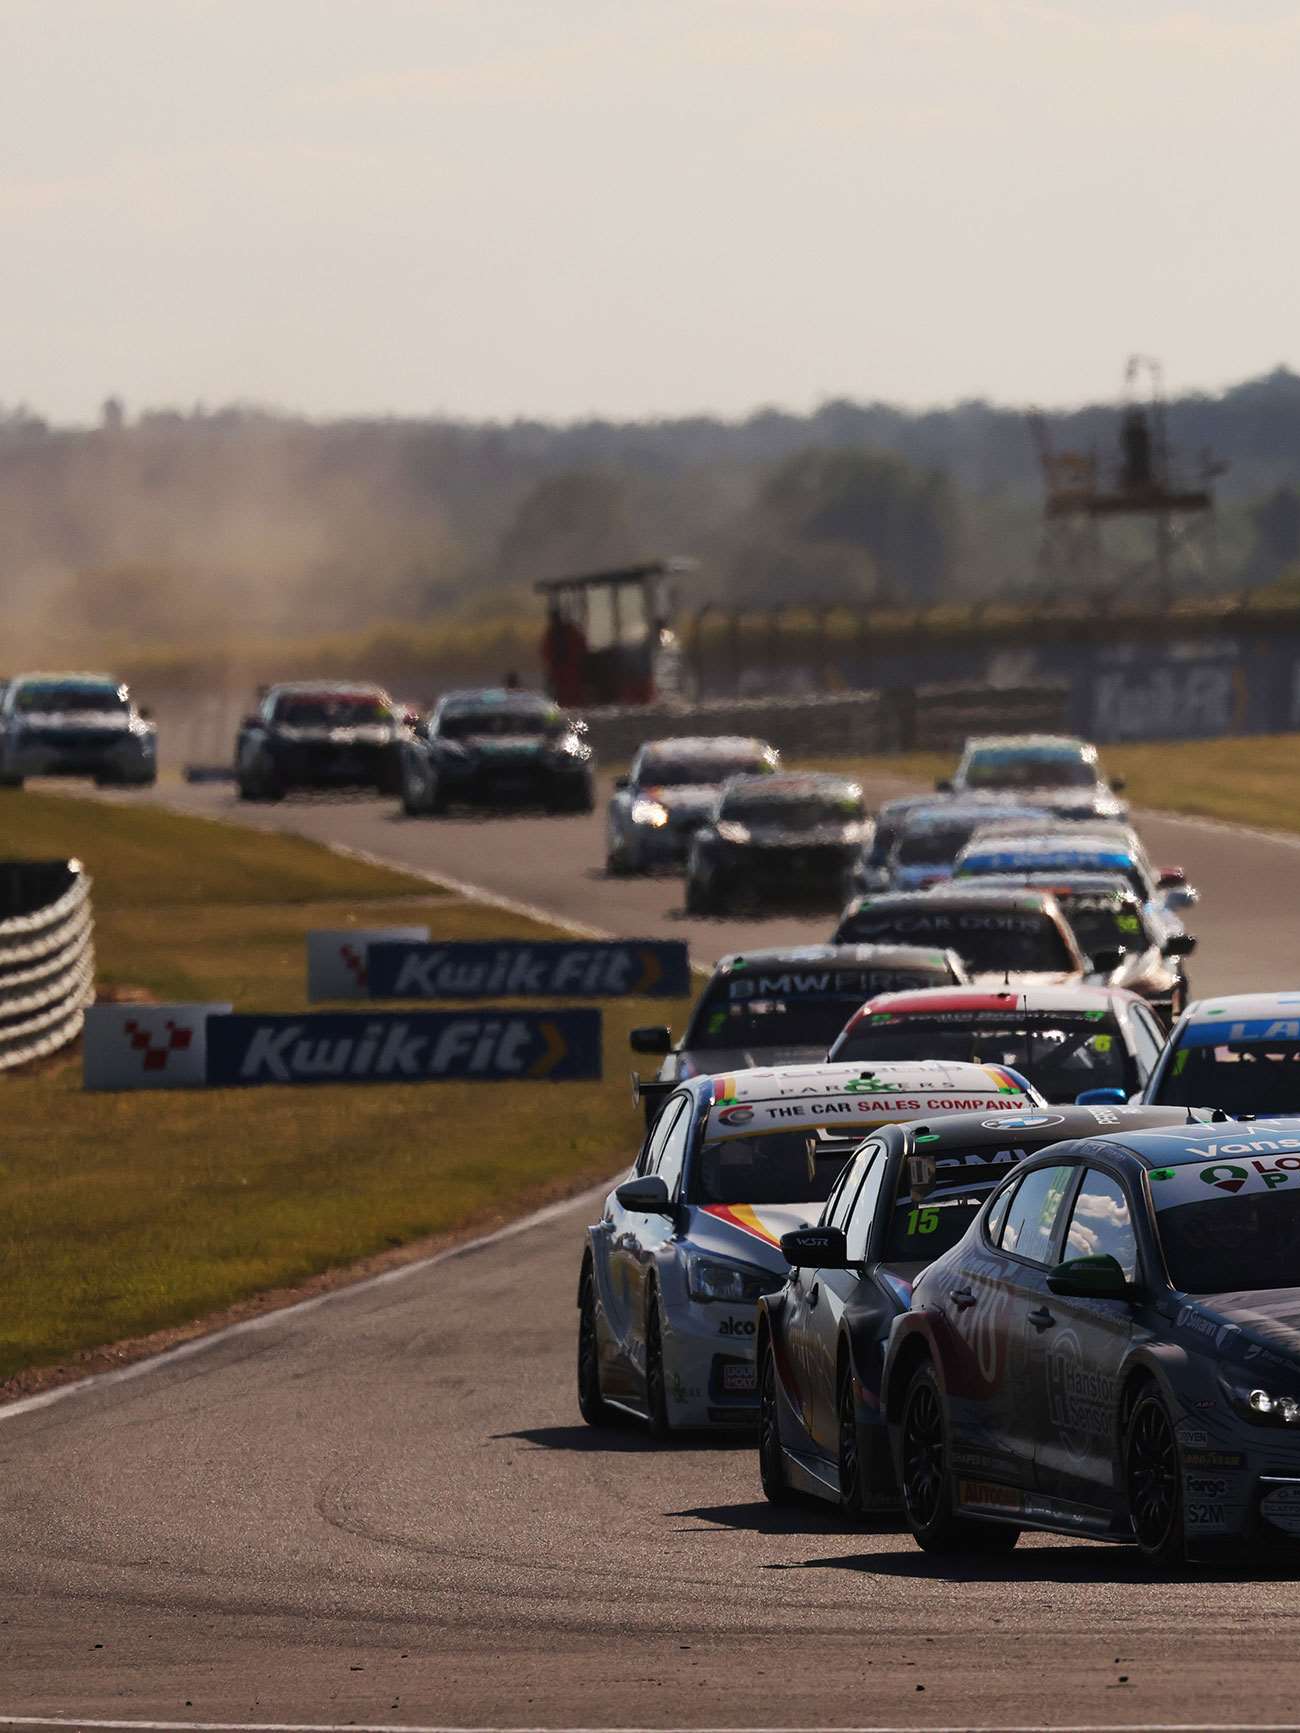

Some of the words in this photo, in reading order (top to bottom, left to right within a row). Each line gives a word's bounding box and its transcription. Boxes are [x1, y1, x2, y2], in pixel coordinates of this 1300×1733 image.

[765, 1106, 806, 1119] THE
[811, 1102, 852, 1115] CAR
[858, 1100, 921, 1112] SALES
[927, 1098, 1024, 1110] COMPANY
[905, 1207, 941, 1236] 15
[1187, 1503, 1225, 1523] S2M
